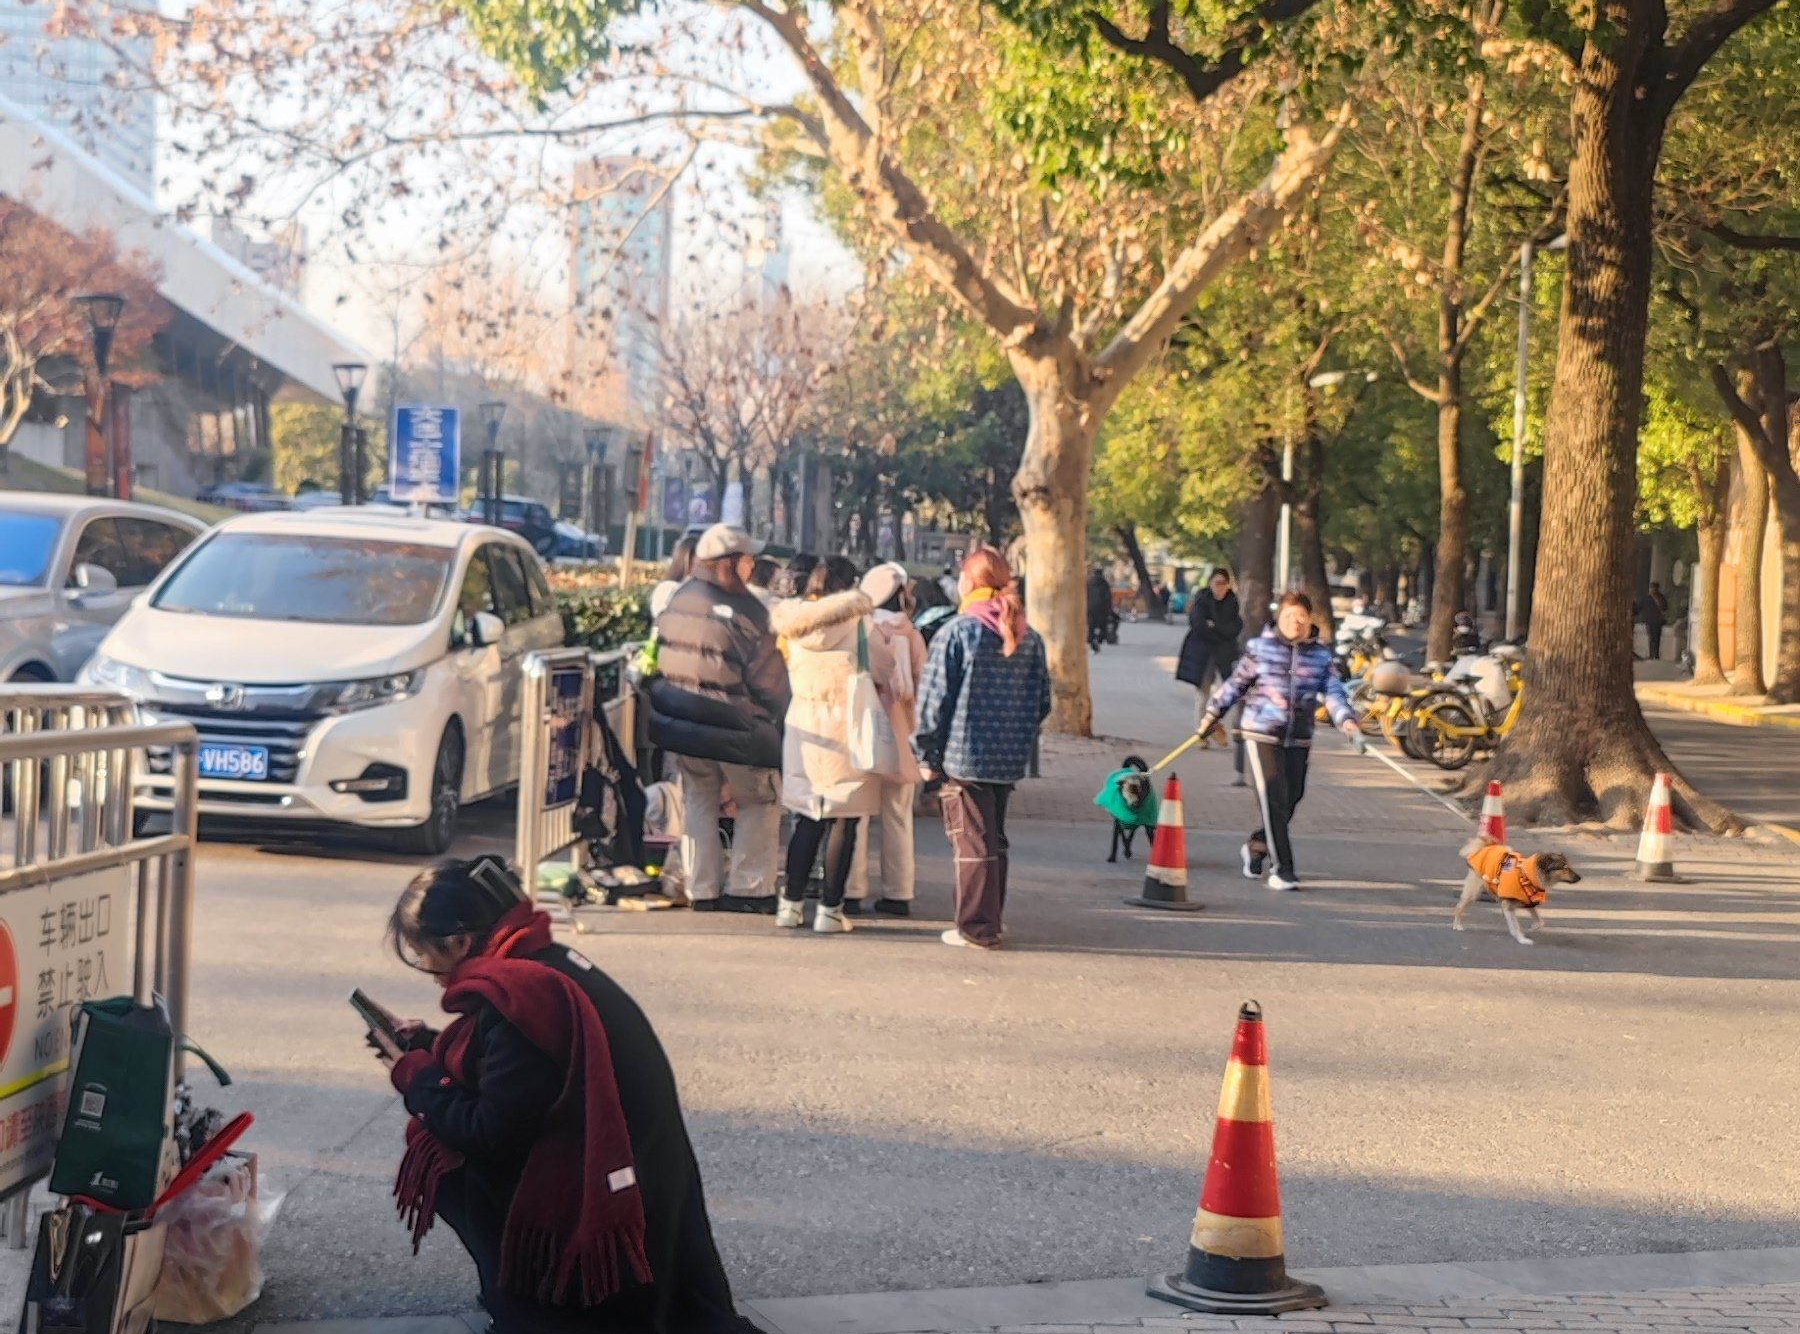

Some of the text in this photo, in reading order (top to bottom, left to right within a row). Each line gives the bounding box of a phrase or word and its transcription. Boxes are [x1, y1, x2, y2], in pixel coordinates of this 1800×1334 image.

[203, 748, 264, 774] VH586
[39, 894, 111, 957] 车辆出口
[37, 950, 109, 1019] 禁止驶入
[34, 1032, 52, 1061] NO
